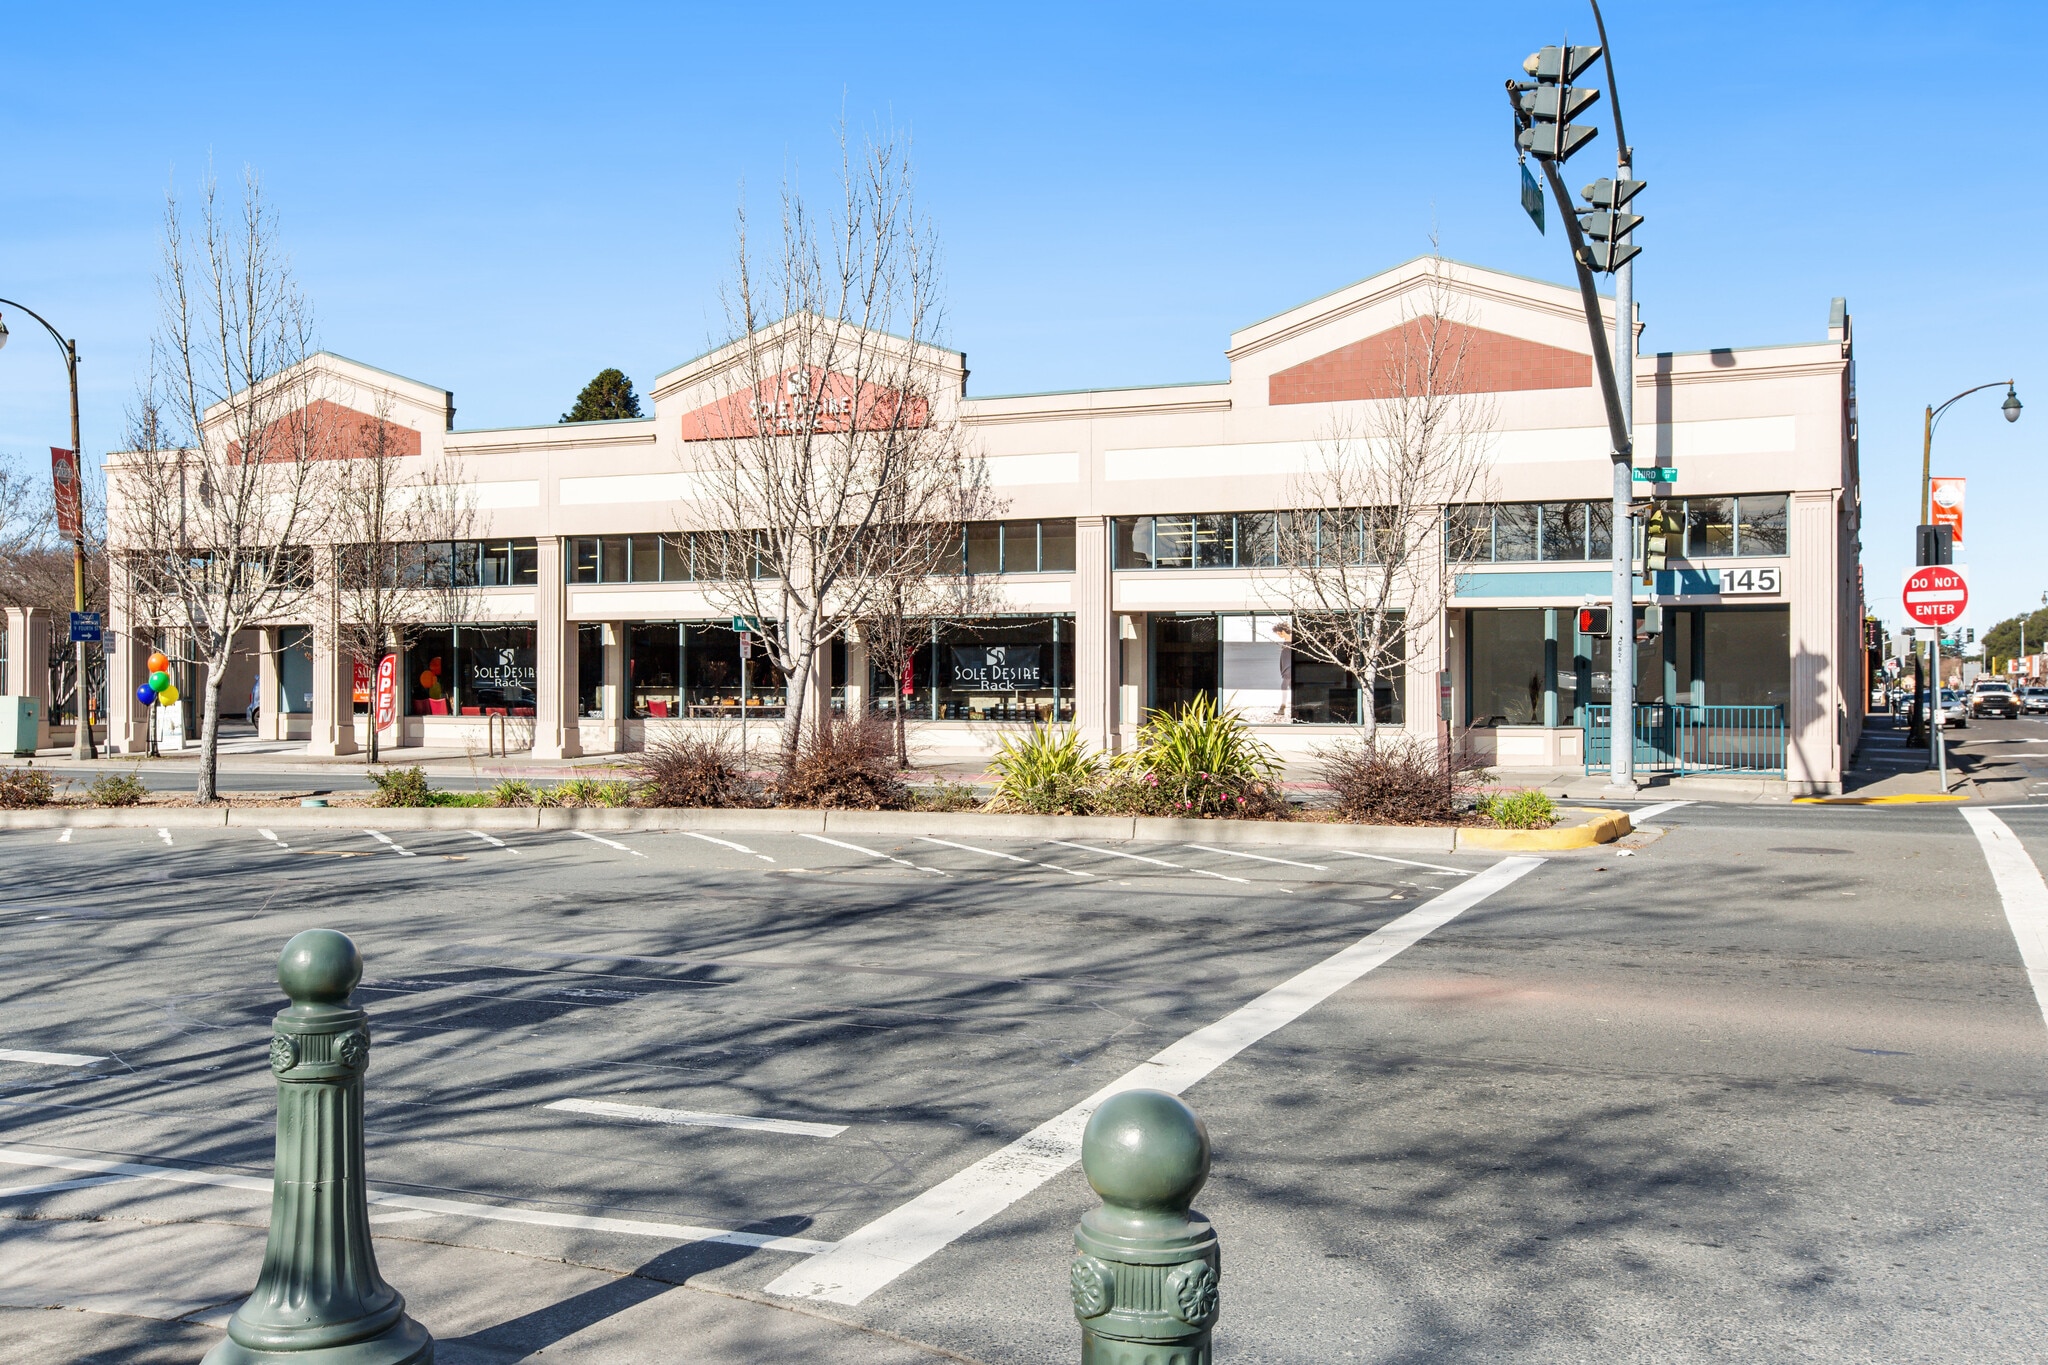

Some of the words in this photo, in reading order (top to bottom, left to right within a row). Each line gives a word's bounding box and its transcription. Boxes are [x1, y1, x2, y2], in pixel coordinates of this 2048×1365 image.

[1634, 470, 1657, 479] THIRD
[1723, 569, 1776, 592] 145
[1911, 578, 1929, 589] DO
[1934, 576, 1960, 588] NOT
[1915, 604, 1956, 616] ENTER
[473, 664, 501, 678] SOLE
[504, 664, 538, 678] DESIR
[954, 665, 988, 680] SOLE
[991, 665, 1040, 680] DESIRE
[494, 678, 522, 687] Rack
[980, 680, 1015, 690] Rack
[379, 661, 392, 723] OPEN
